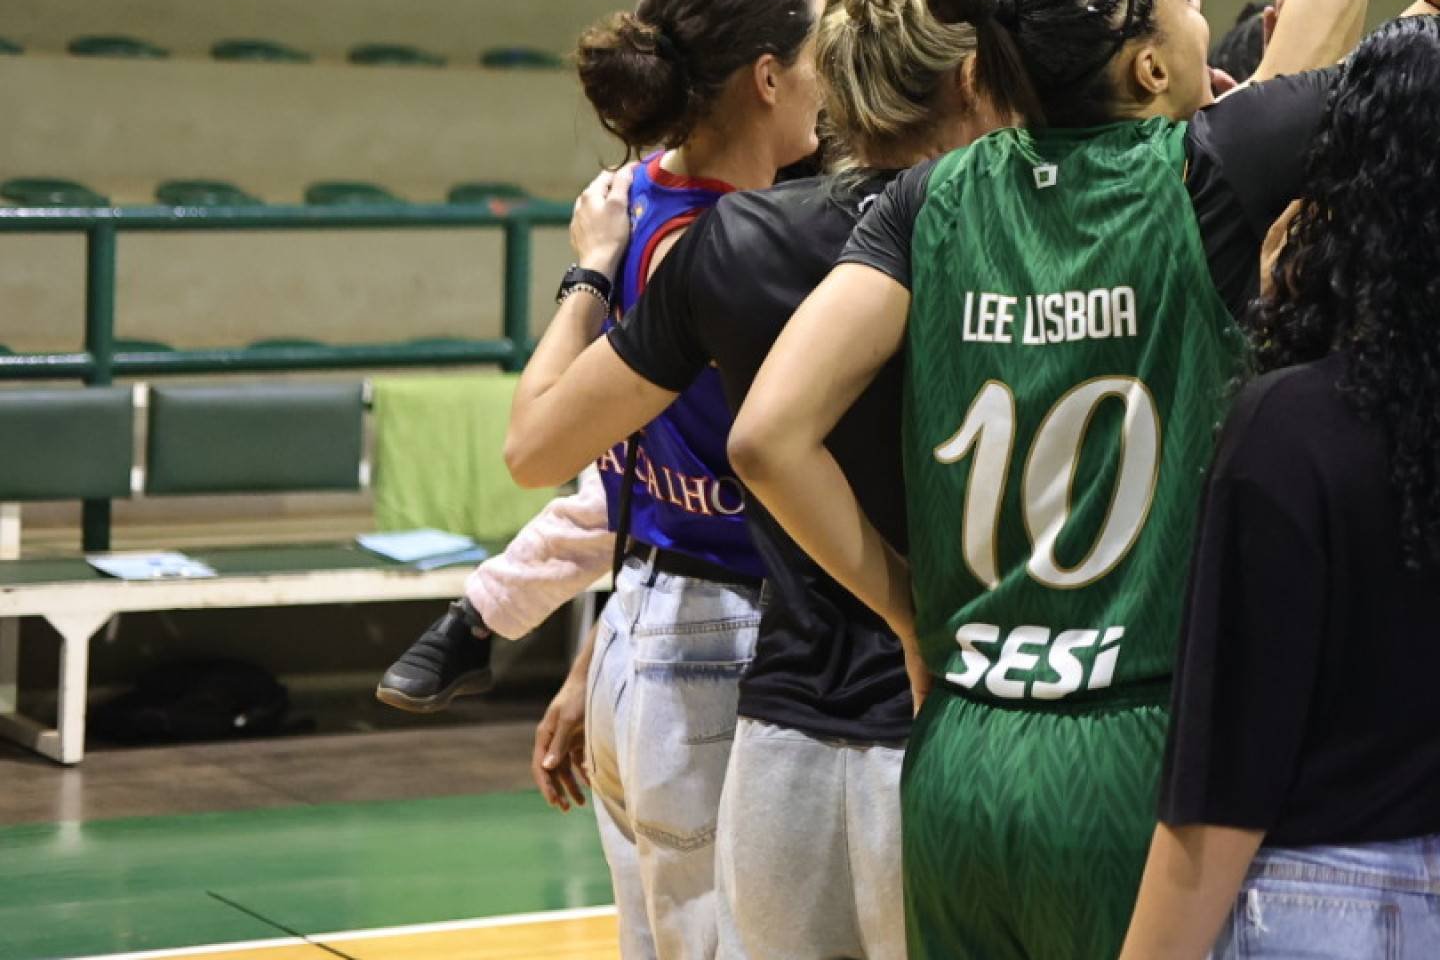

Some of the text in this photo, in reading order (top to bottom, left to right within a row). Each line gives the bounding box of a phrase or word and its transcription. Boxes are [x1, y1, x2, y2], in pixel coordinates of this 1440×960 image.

[962, 285, 1138, 346] LEE LISBOA
[933, 375, 1162, 591] 10
